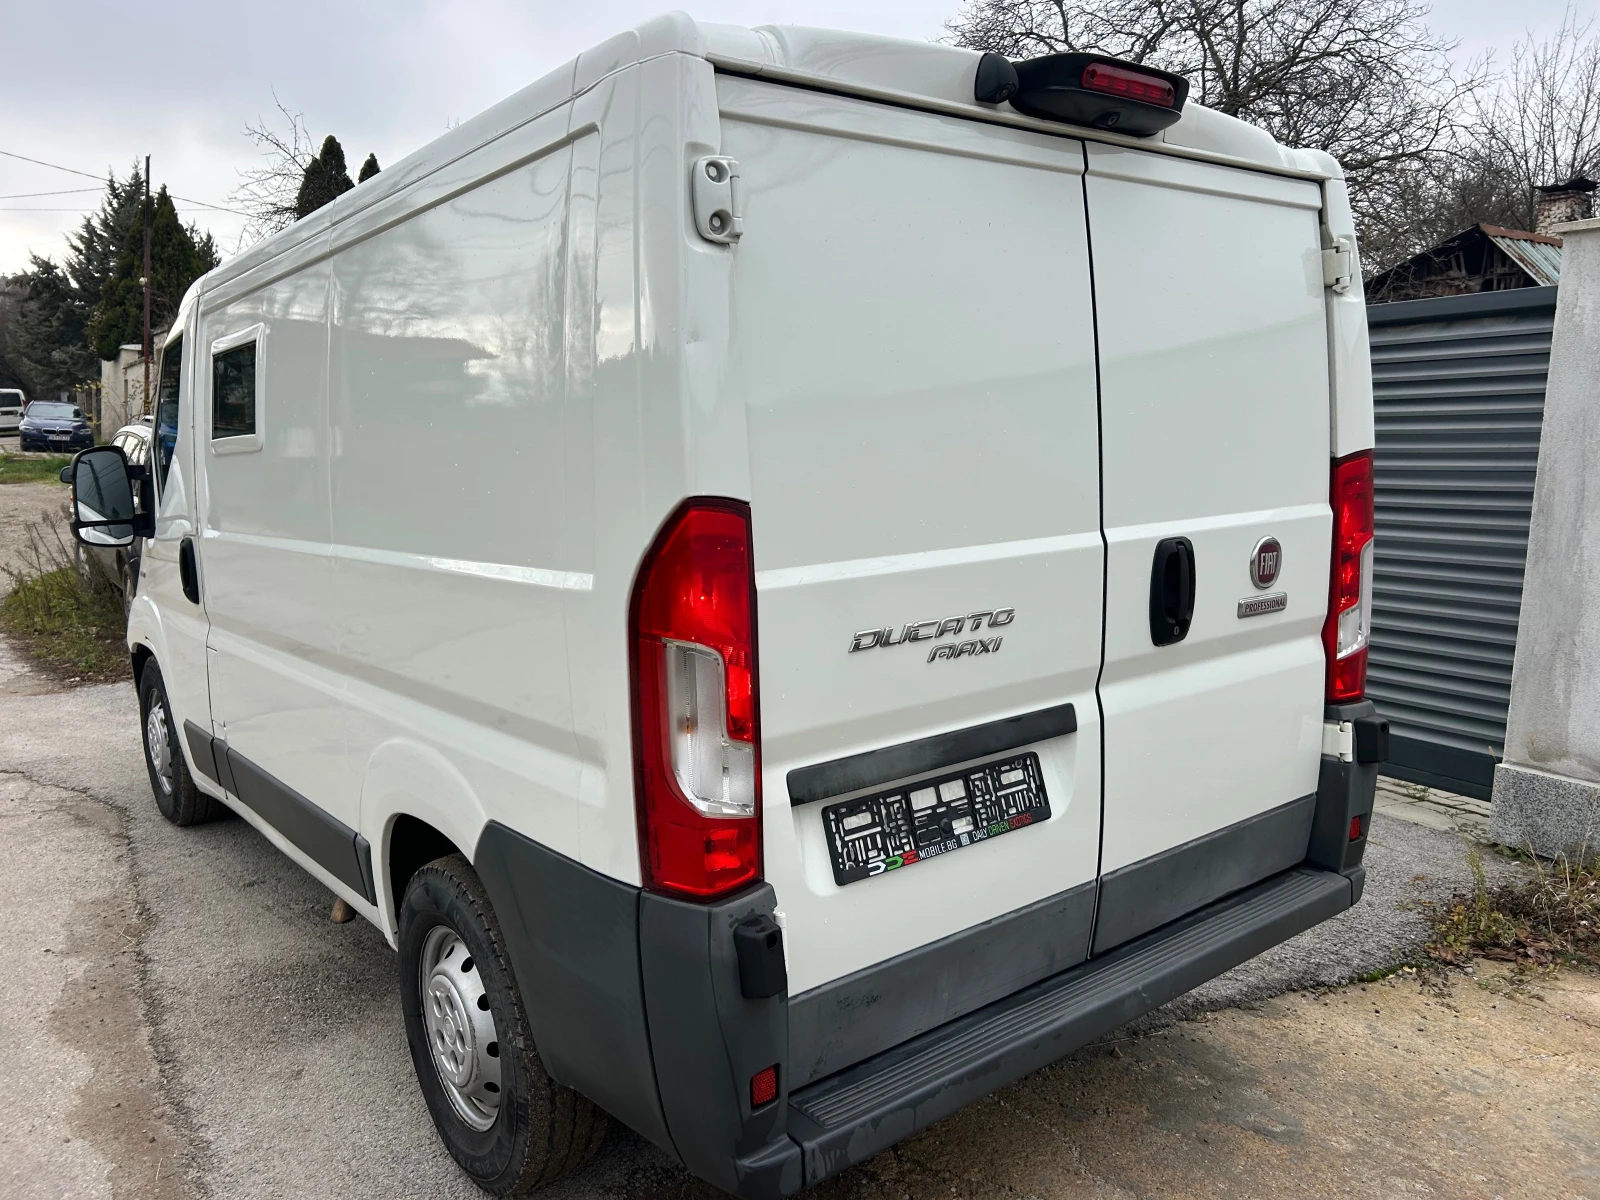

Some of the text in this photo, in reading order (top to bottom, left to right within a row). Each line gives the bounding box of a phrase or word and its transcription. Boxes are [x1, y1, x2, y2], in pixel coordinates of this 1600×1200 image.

[1259, 551, 1278, 576] FIAT
[1244, 597, 1286, 613] PROFESSIONAL
[847, 606, 1016, 653] DUCATO
[926, 636, 1004, 663] MAXI
[972, 827, 988, 841] DAILY
[988, 820, 1010, 836] DRIVEN
[1009, 813, 1033, 829] EXOTICS
